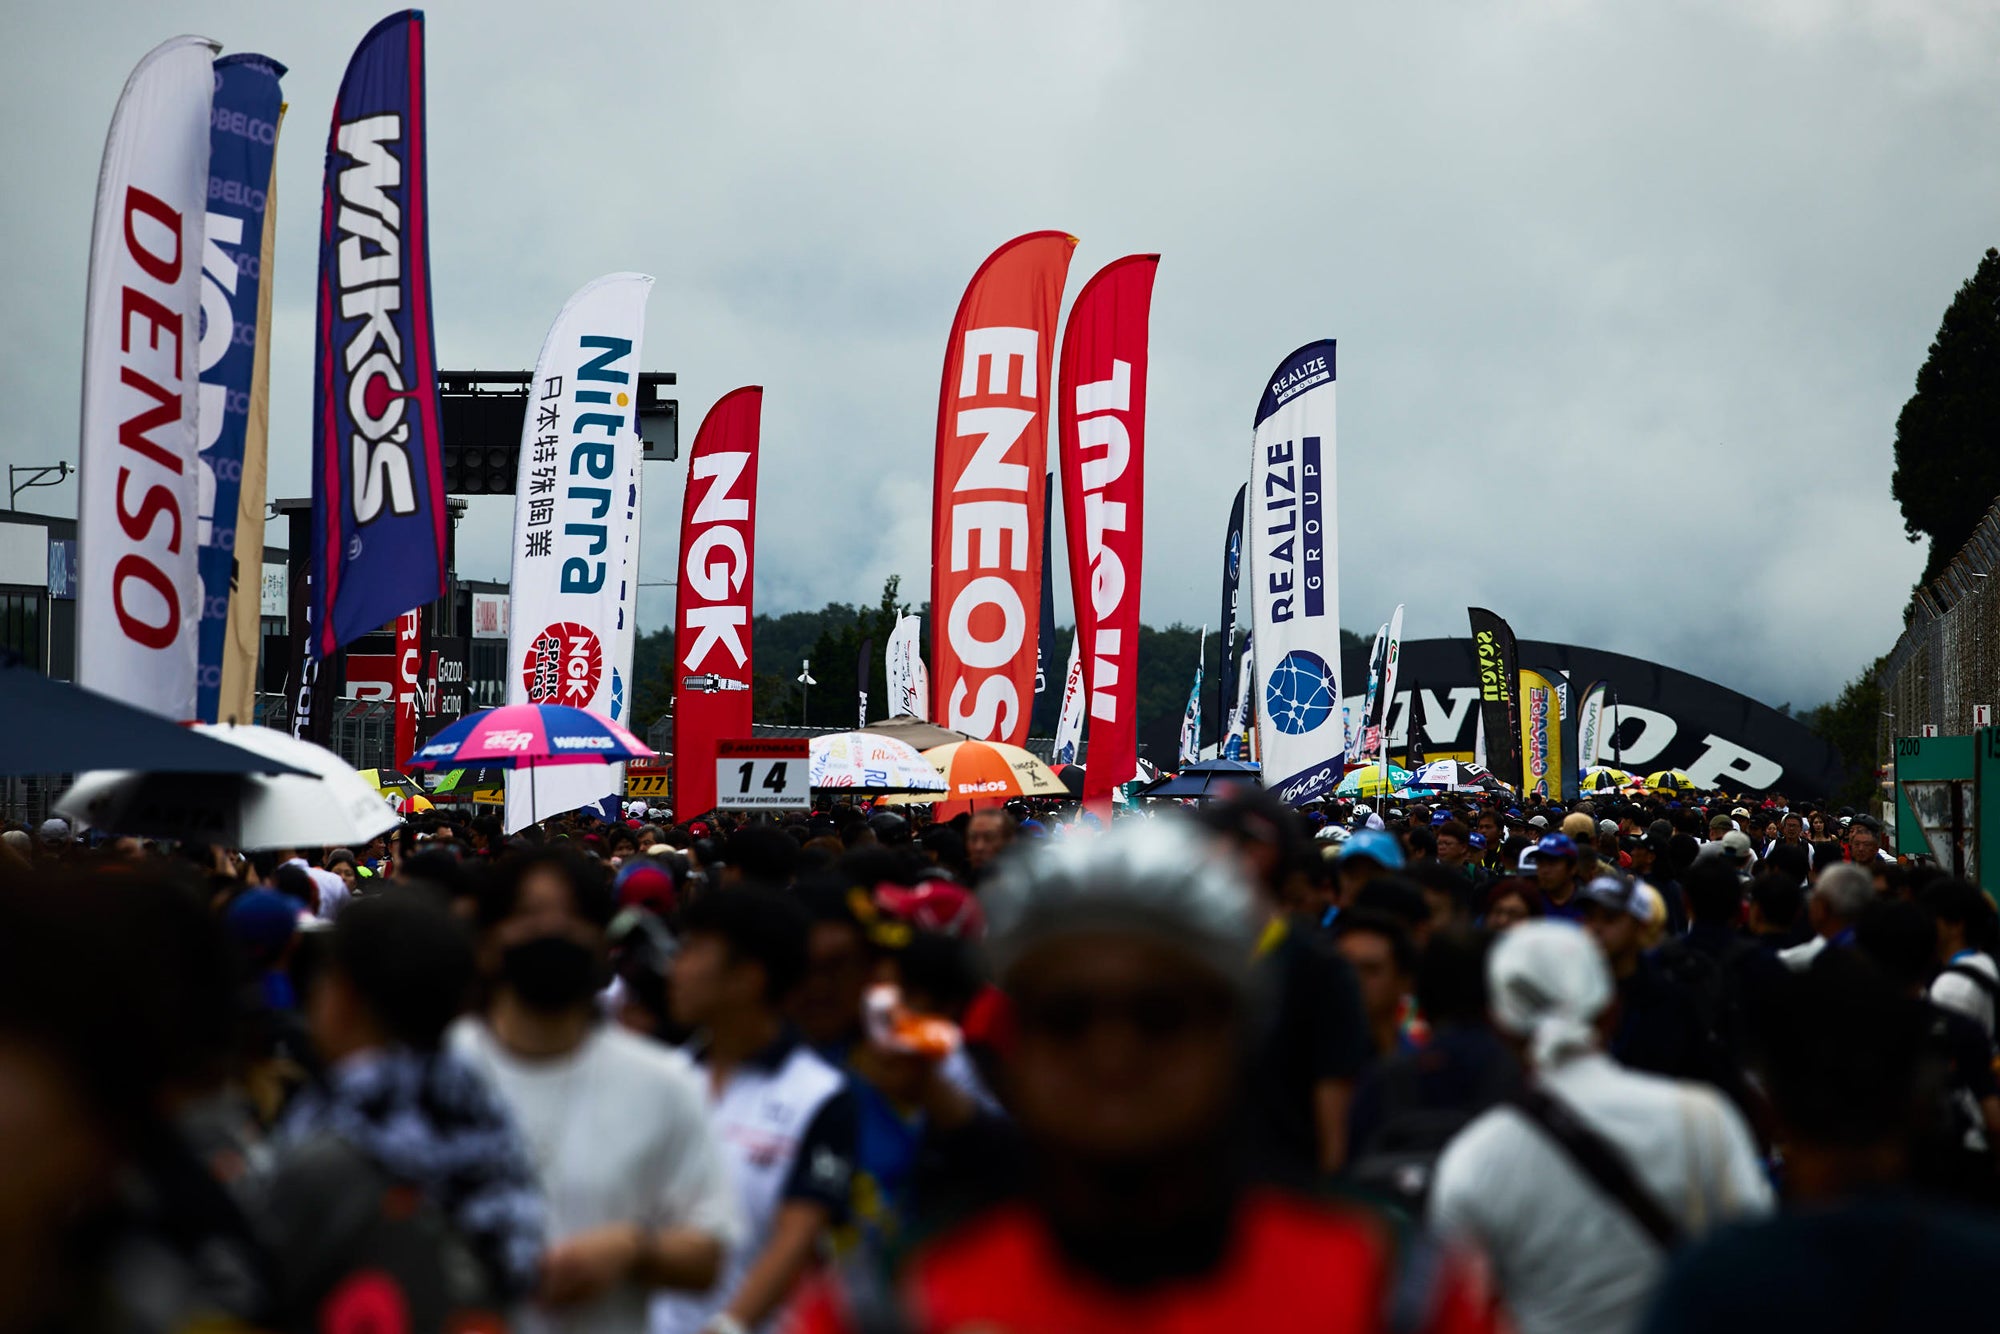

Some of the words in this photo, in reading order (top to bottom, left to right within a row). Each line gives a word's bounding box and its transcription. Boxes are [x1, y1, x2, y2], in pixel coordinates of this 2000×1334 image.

[210, 107, 276, 145] BELCO
[1272, 356, 1327, 396] REALIZE
[1283, 375, 1321, 398] GROUP
[113, 185, 183, 650] DENSO
[525, 375, 563, 558] 日本特殊陶業
[561, 335, 633, 594] Niterra
[948, 327, 1039, 742] ENEOS
[1265, 440, 1296, 624] REALIZE
[1305, 463, 1321, 590] GROUP
[683, 451, 752, 672] NGK
[438, 657, 462, 682] GAZOO
[533, 639, 546, 699] PLUGS
[546, 638, 560, 698] SPARK
[565, 635, 590, 698] NGK
[739, 761, 787, 793] 14
[1899, 739, 1920, 756] 200
[631, 777, 665, 790] 777
[958, 780, 1008, 794] ENEOS
